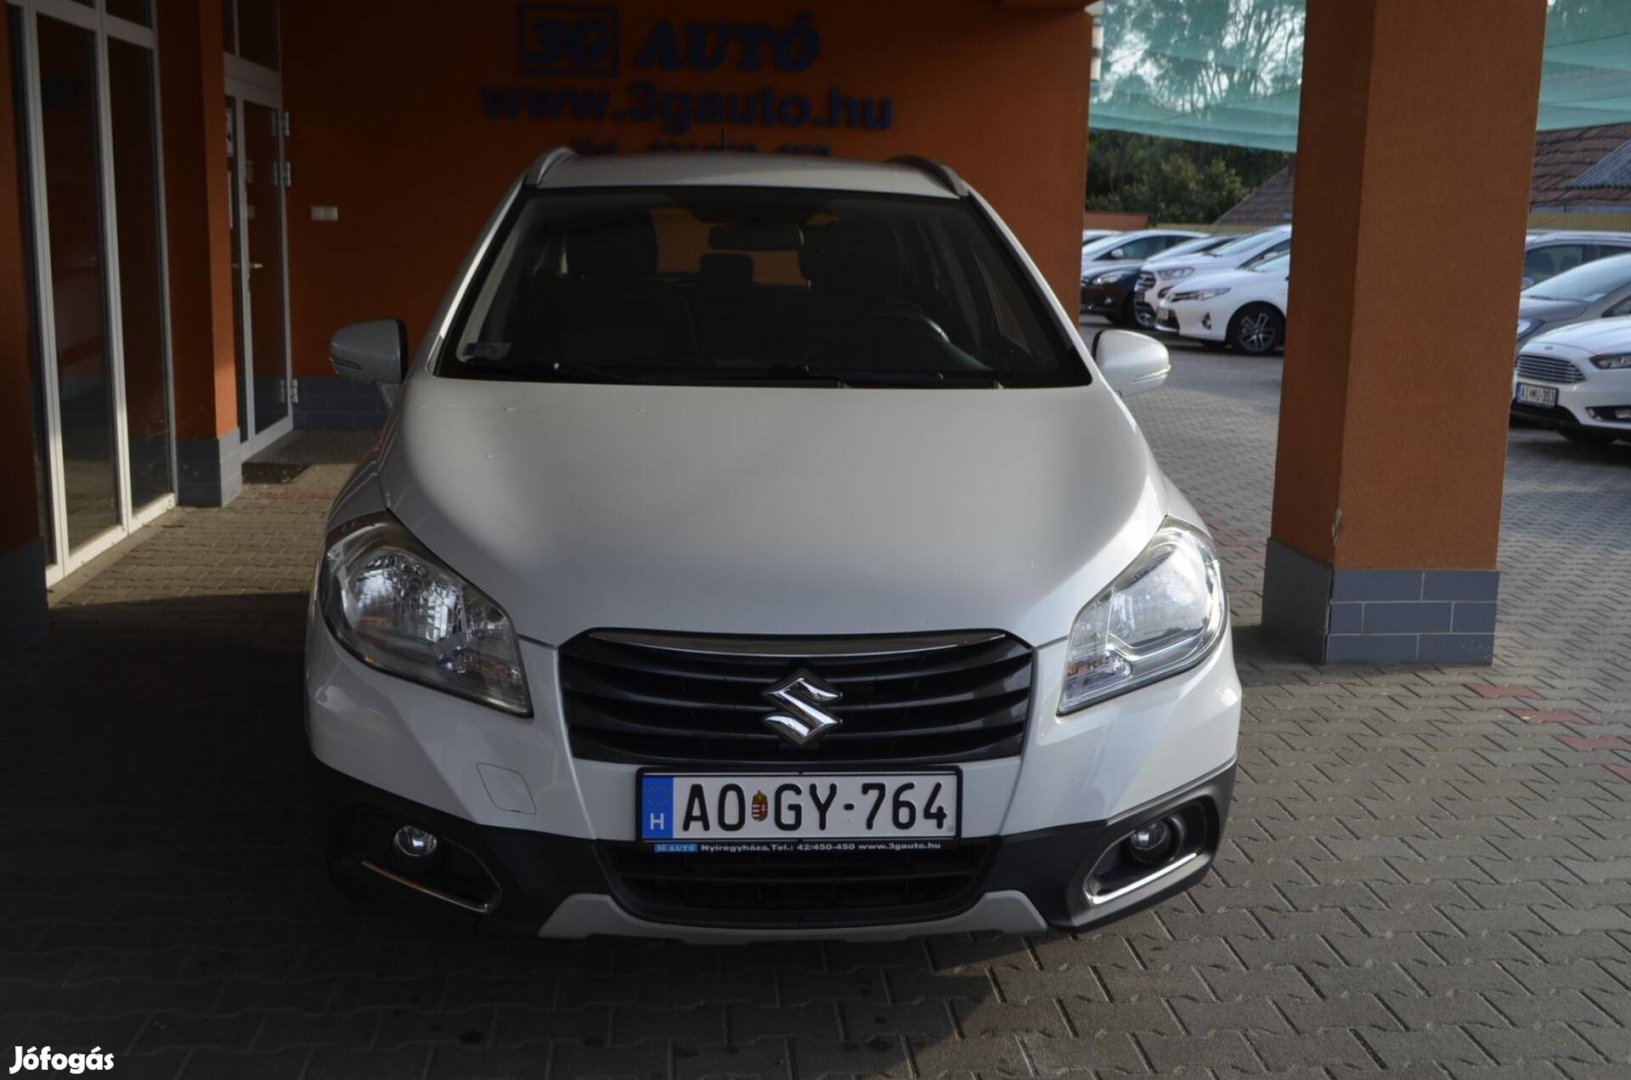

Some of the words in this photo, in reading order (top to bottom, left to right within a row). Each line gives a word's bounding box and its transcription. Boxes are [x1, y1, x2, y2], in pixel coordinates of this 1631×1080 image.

[522, 18, 610, 66] 3G
[633, 9, 821, 73] AUTÓ
[480, 81, 893, 134] www.3gauto.hu
[650, 813, 664, 830] H
[682, 783, 746, 832] AO
[774, 782, 948, 831] GY-764
[858, 842, 941, 851] www.3gauto.hu
